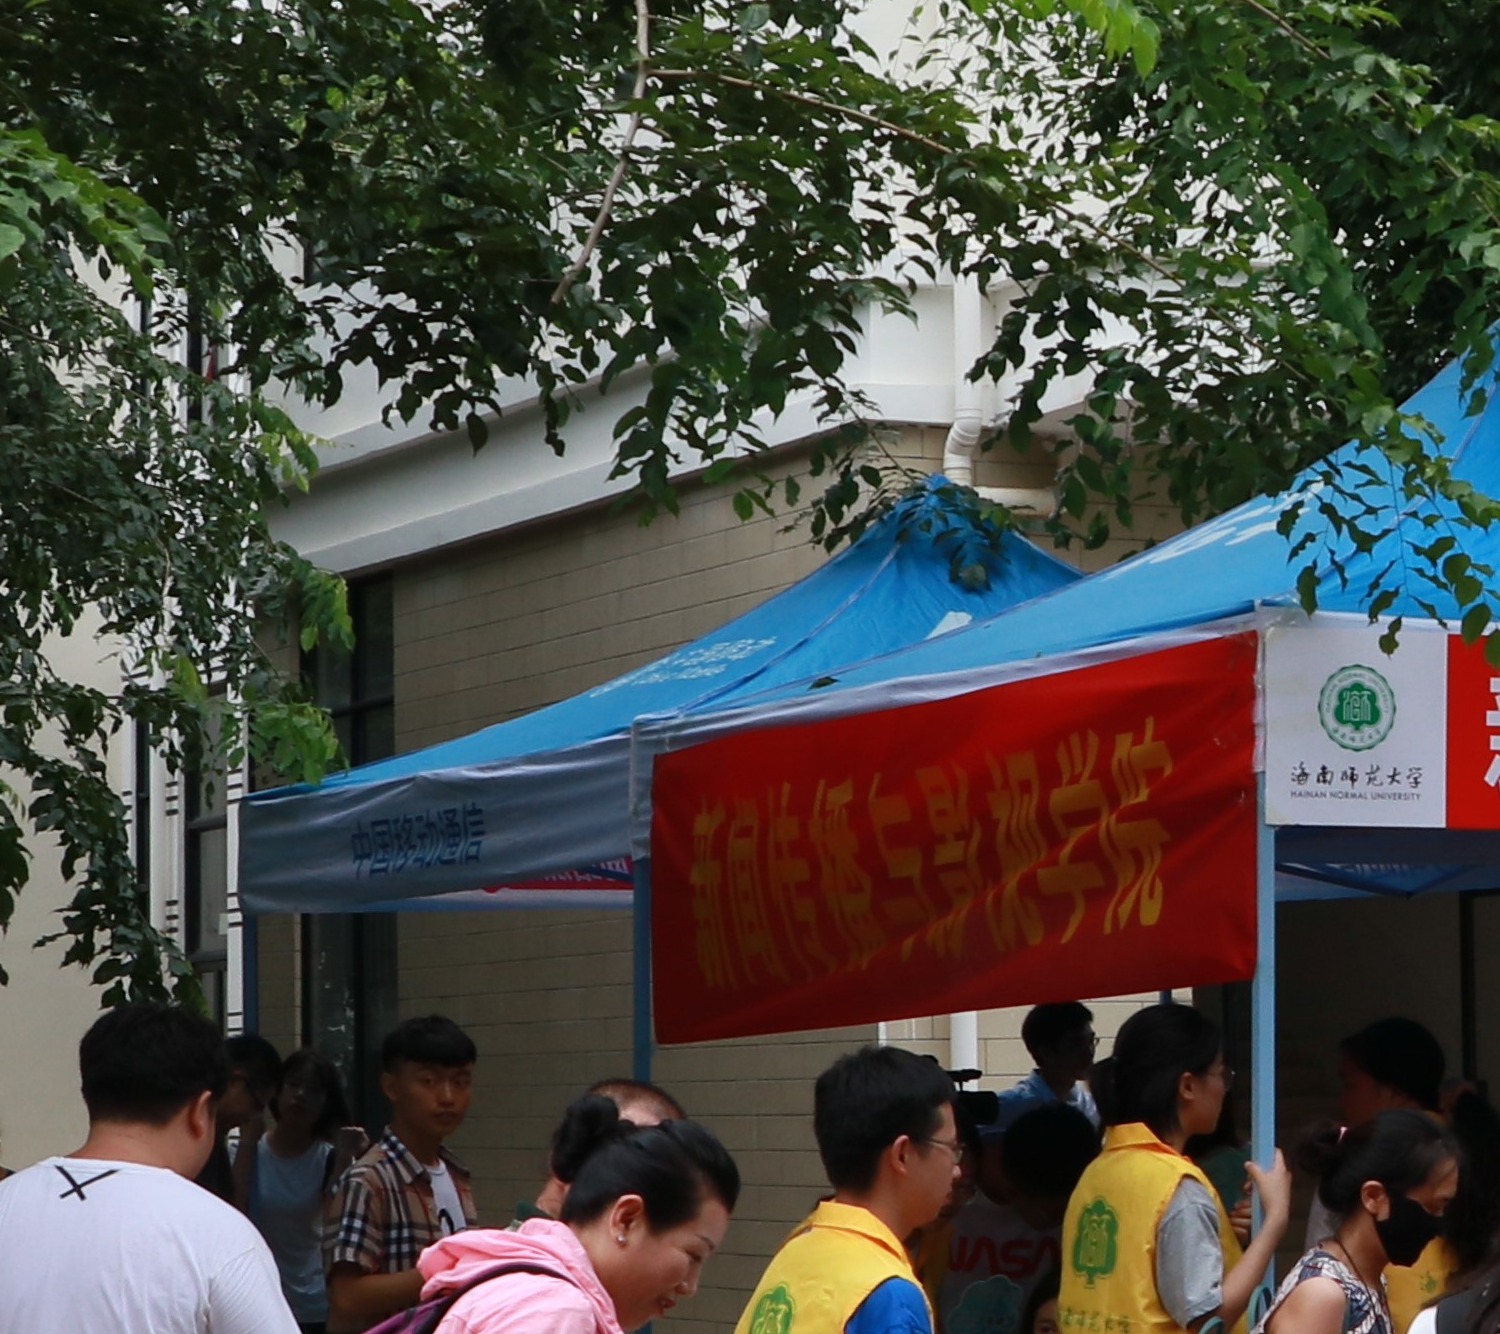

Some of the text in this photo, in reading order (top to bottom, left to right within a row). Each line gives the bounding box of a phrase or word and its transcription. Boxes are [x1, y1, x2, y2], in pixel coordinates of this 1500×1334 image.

[1290, 790, 1421, 802] HAINAN NORMAL UNIVERSITY
[1291, 761, 1422, 789] 海南师范大学
[352, 802, 485, 880] 中国移动通信
[688, 716, 1173, 989] 新闻传播与影视学院
